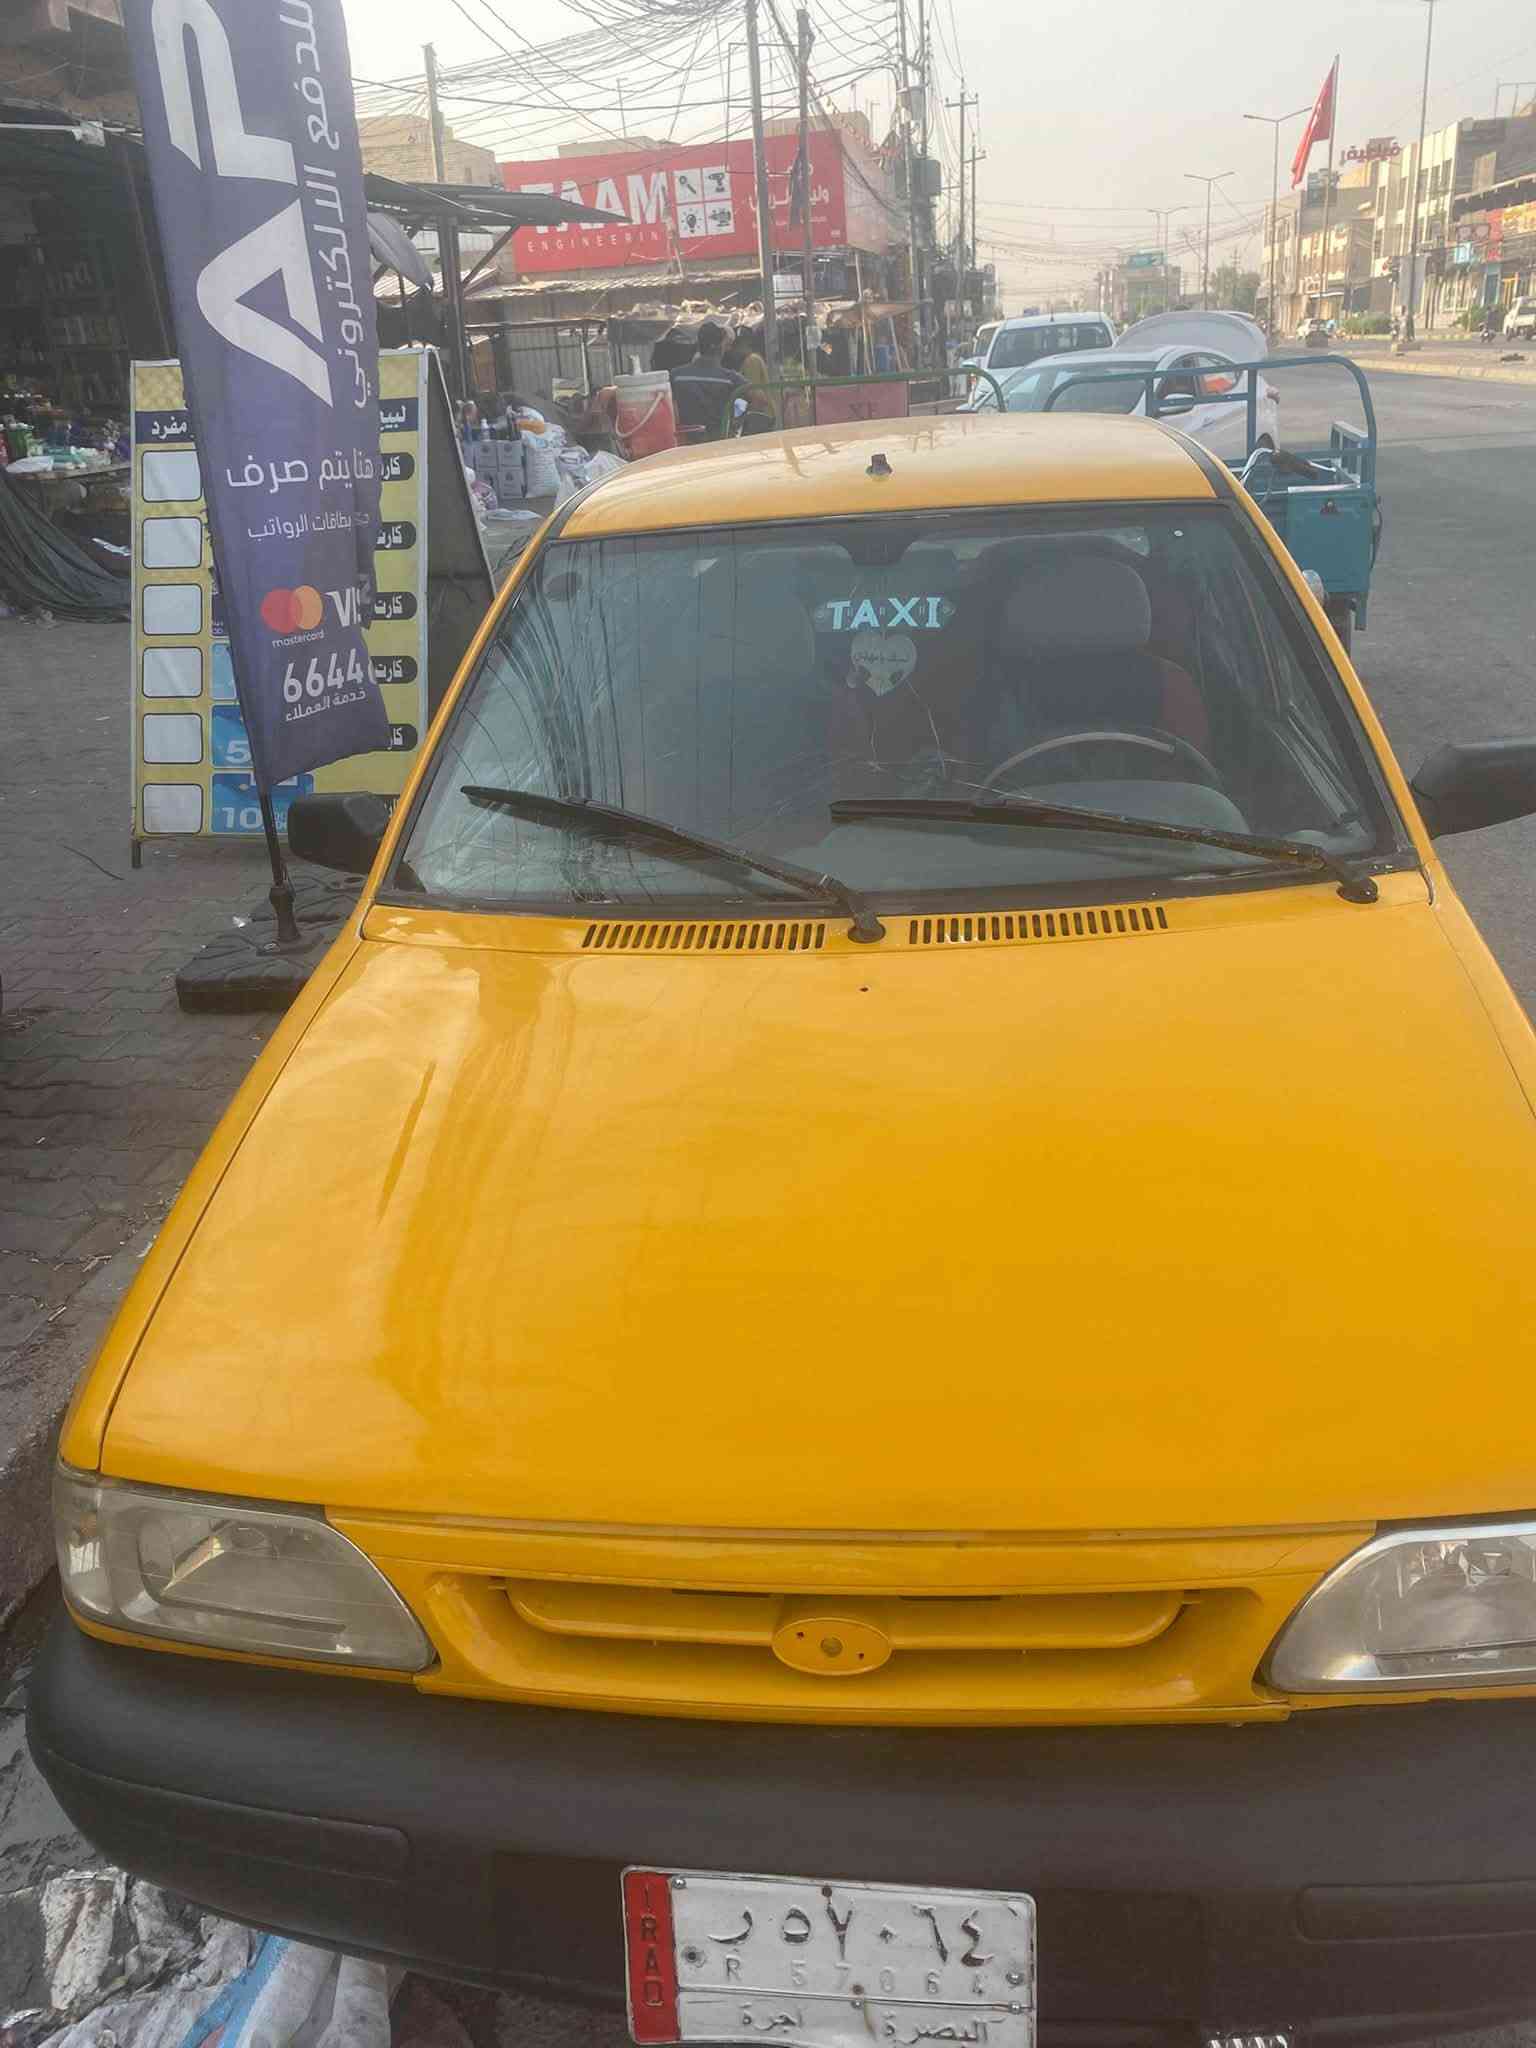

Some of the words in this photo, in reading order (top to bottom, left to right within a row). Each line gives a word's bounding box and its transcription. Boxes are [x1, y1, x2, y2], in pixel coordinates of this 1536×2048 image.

[527, 231, 671, 254] ENGINEERIN
[151, 415, 188, 440] مفرد
[226, 454, 308, 494] صرف
[318, 450, 351, 490] يتم
[352, 448, 376, 482] هنا
[248, 513, 308, 542] الرواتب
[374, 594, 403, 619] كارت
[826, 596, 942, 630] TAXI
[271, 629, 325, 649] mastercard
[283, 648, 364, 704] 6644
[374, 659, 403, 683] كارت
[285, 697, 331, 722] العملاء
[331, 689, 367, 707] خدمة
[640, 1885, 665, 2009] IRAQ
[883, 2012, 990, 2047] البصرة
